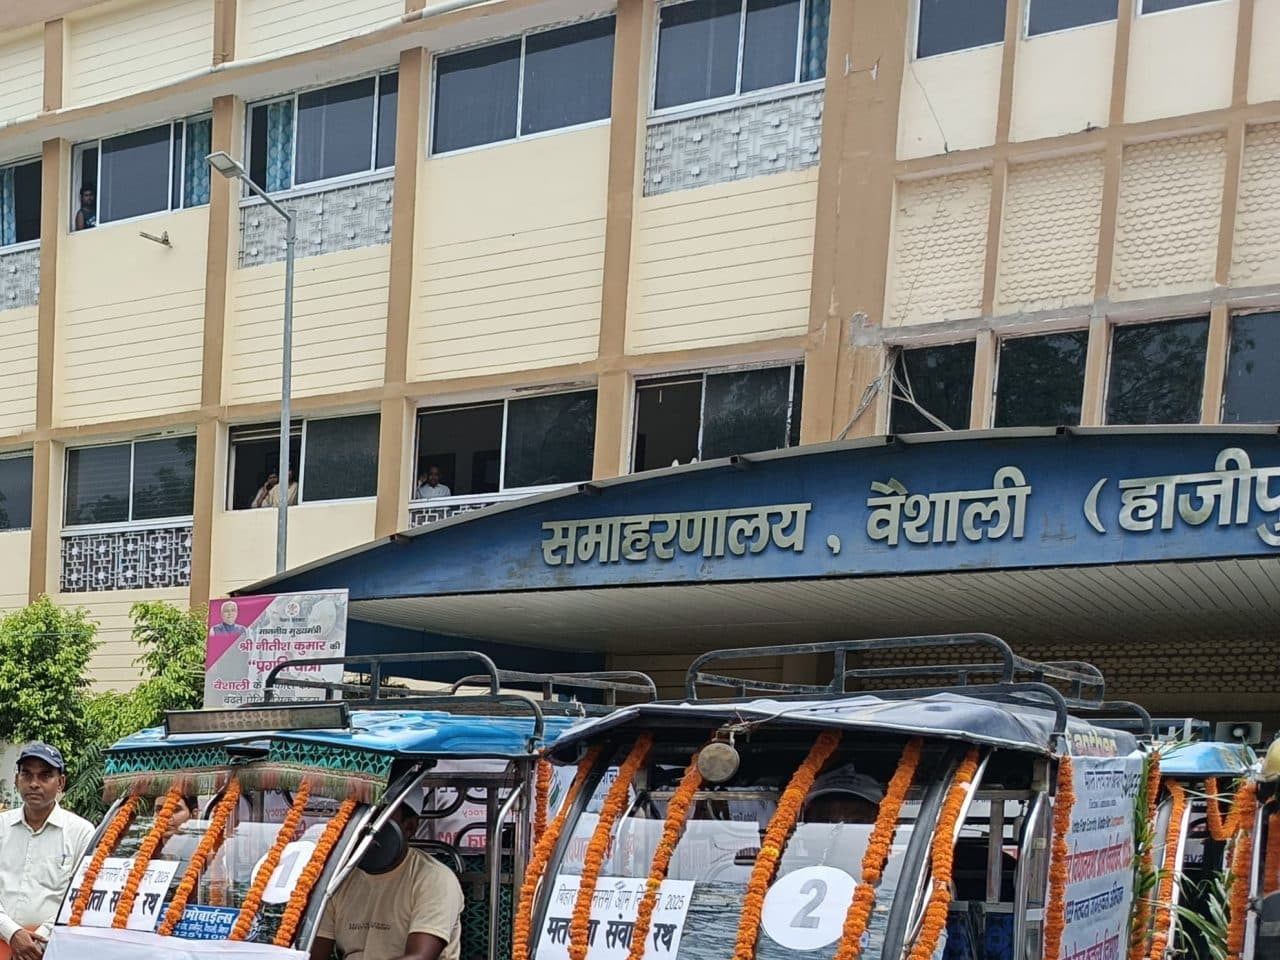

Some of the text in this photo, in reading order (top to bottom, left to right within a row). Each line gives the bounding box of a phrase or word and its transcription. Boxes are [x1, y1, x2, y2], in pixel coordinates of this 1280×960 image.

[866, 465, 1031, 546] वैशाली
[240, 638, 253, 652] श्री
[256, 638, 290, 652] नीतीश
[294, 640, 326, 655] कुमार
[213, 678, 250, 691] वैशाली
[789, 878, 828, 930] 2
[606, 913, 634, 949] संवा
[653, 922, 677, 952] रथ
